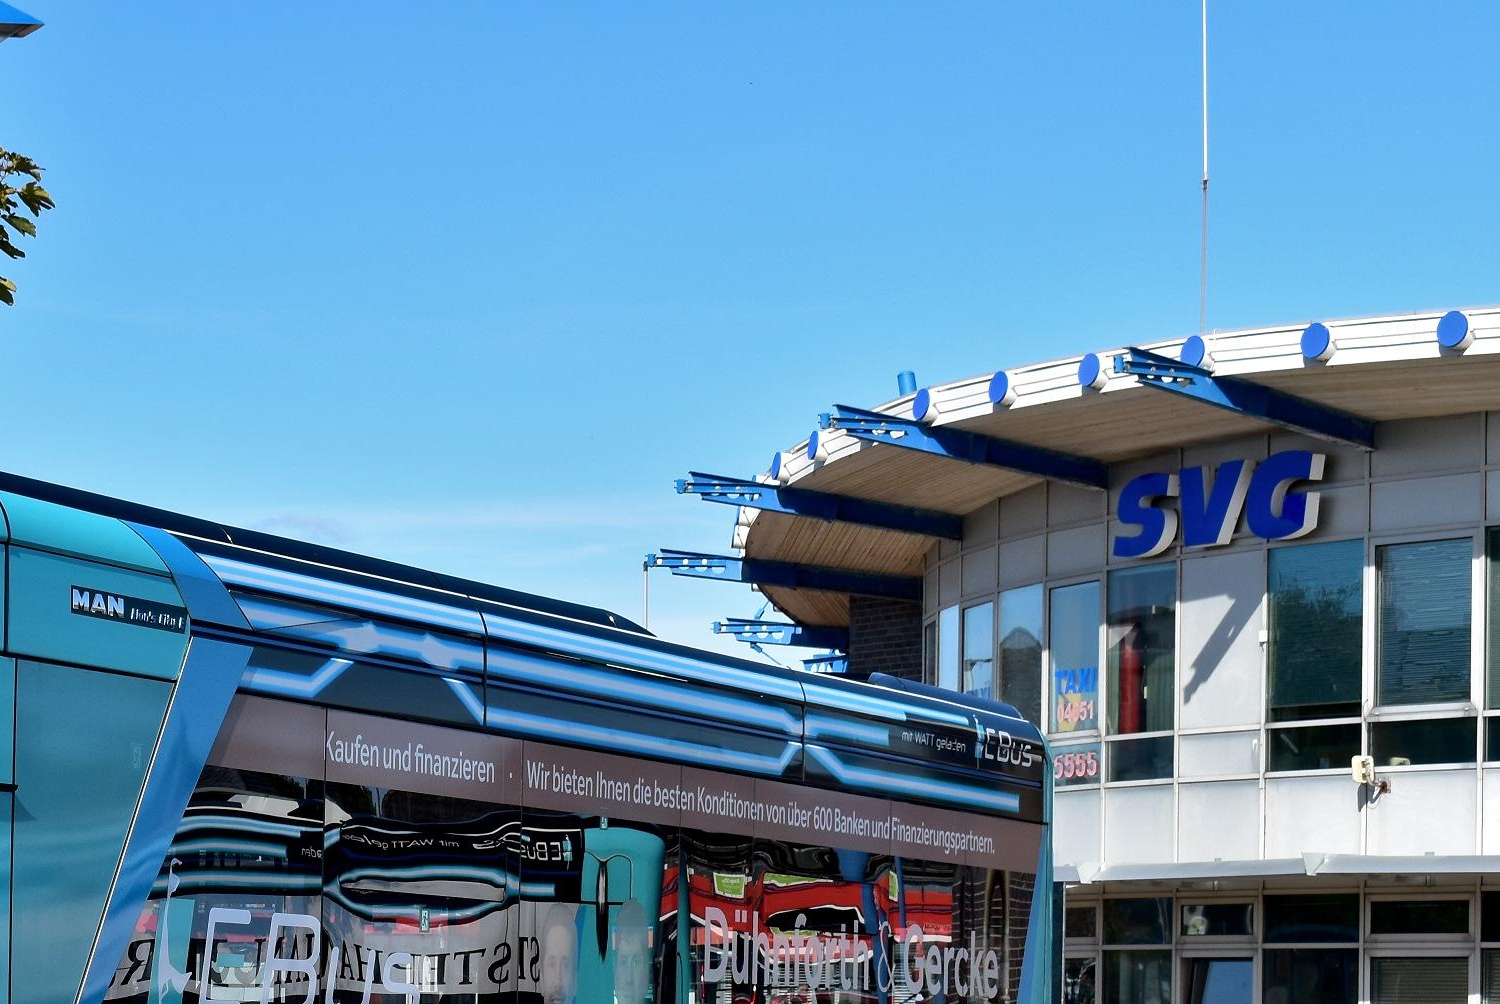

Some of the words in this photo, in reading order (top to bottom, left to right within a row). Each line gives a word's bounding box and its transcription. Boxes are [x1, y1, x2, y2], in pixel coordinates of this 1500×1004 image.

[1113, 449, 1325, 558] SVG
[73, 588, 125, 618] MAN
[1055, 667, 1098, 695] TAXI
[324, 730, 379, 767] Kaufen
[384, 743, 411, 772] und
[414, 743, 495, 783] finanzieren
[901, 730, 914, 742] mit
[914, 730, 935, 746] WATT
[936, 738, 966, 753] geladen
[1054, 752, 1097, 779] 5555
[527, 760, 550, 790] Wir
[552, 764, 592, 797] bieten
[596, 770, 630, 802] Ihnen
[633, 778, 651, 805] die
[655, 780, 694, 812] besten
[697, 787, 764, 821] Konditionen
[766, 804, 786, 824] von
[788, 802, 811, 829] über
[813, 806, 832, 831] 600
[834, 808, 870, 836] Banken
[871, 815, 890, 840] und
[891, 817, 995, 855] Finanzierungspartnern.
[704, 906, 869, 992] Dühnforth
[877, 920, 895, 994] &
[903, 923, 998, 999] Gercke
